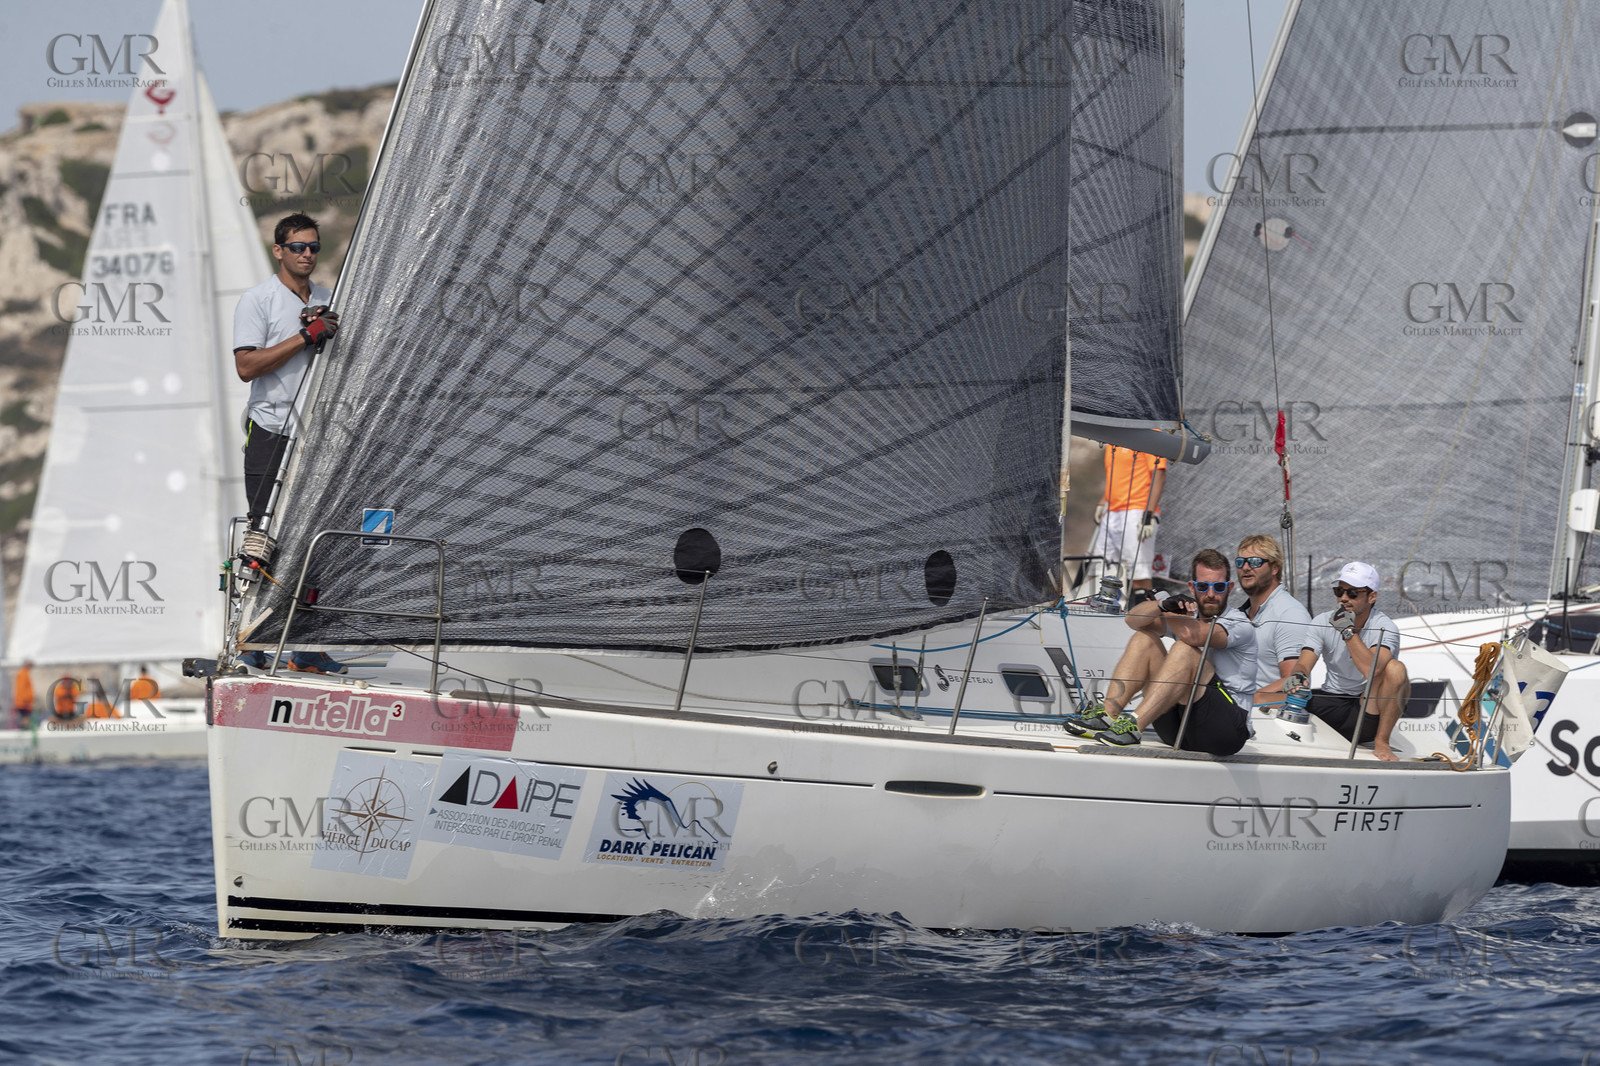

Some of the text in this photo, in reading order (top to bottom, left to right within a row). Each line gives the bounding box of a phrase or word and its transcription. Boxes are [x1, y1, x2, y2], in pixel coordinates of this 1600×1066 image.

[104, 203, 157, 226] FRA
[1338, 785, 1379, 805] 31.7
[327, 823, 338, 831] LA
[437, 810, 546, 835] ASSOCIATION DES AVOCATS
[1334, 811, 1403, 831] FIRST
[321, 831, 412, 852] VIERGE DU CAP
[434, 820, 563, 849] INTERESSES PAR LE DROIT PENAL
[599, 839, 646, 855] DARK
[650, 843, 716, 860] PELICAN
[596, 854, 633, 862] LOCATION
[671, 859, 712, 867] ENTRETIEN
